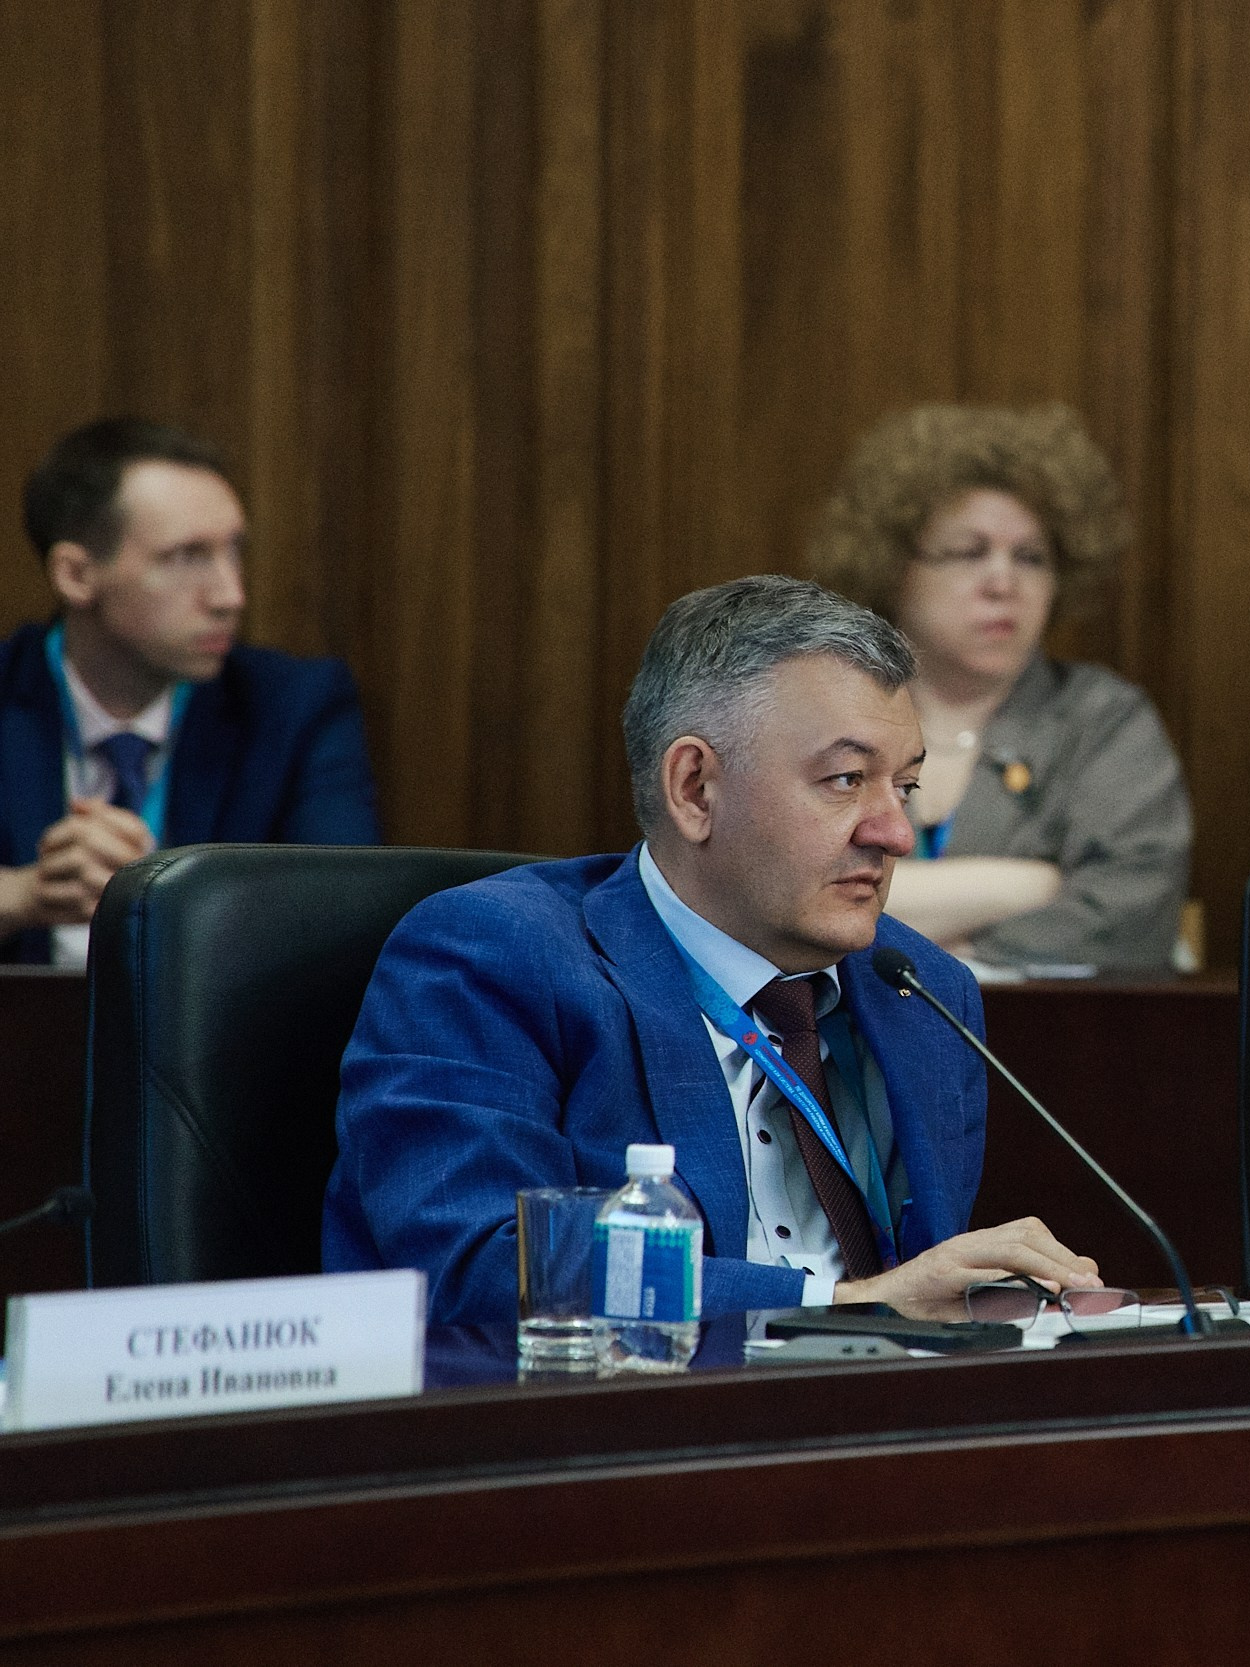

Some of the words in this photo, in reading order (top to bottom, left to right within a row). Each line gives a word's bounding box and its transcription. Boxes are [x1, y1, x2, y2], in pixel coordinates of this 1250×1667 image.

[126, 1315, 321, 1358] СТЕФАНЮК
[105, 1372, 190, 1402] Елена
[201, 1366, 337, 1397] Ивановна
